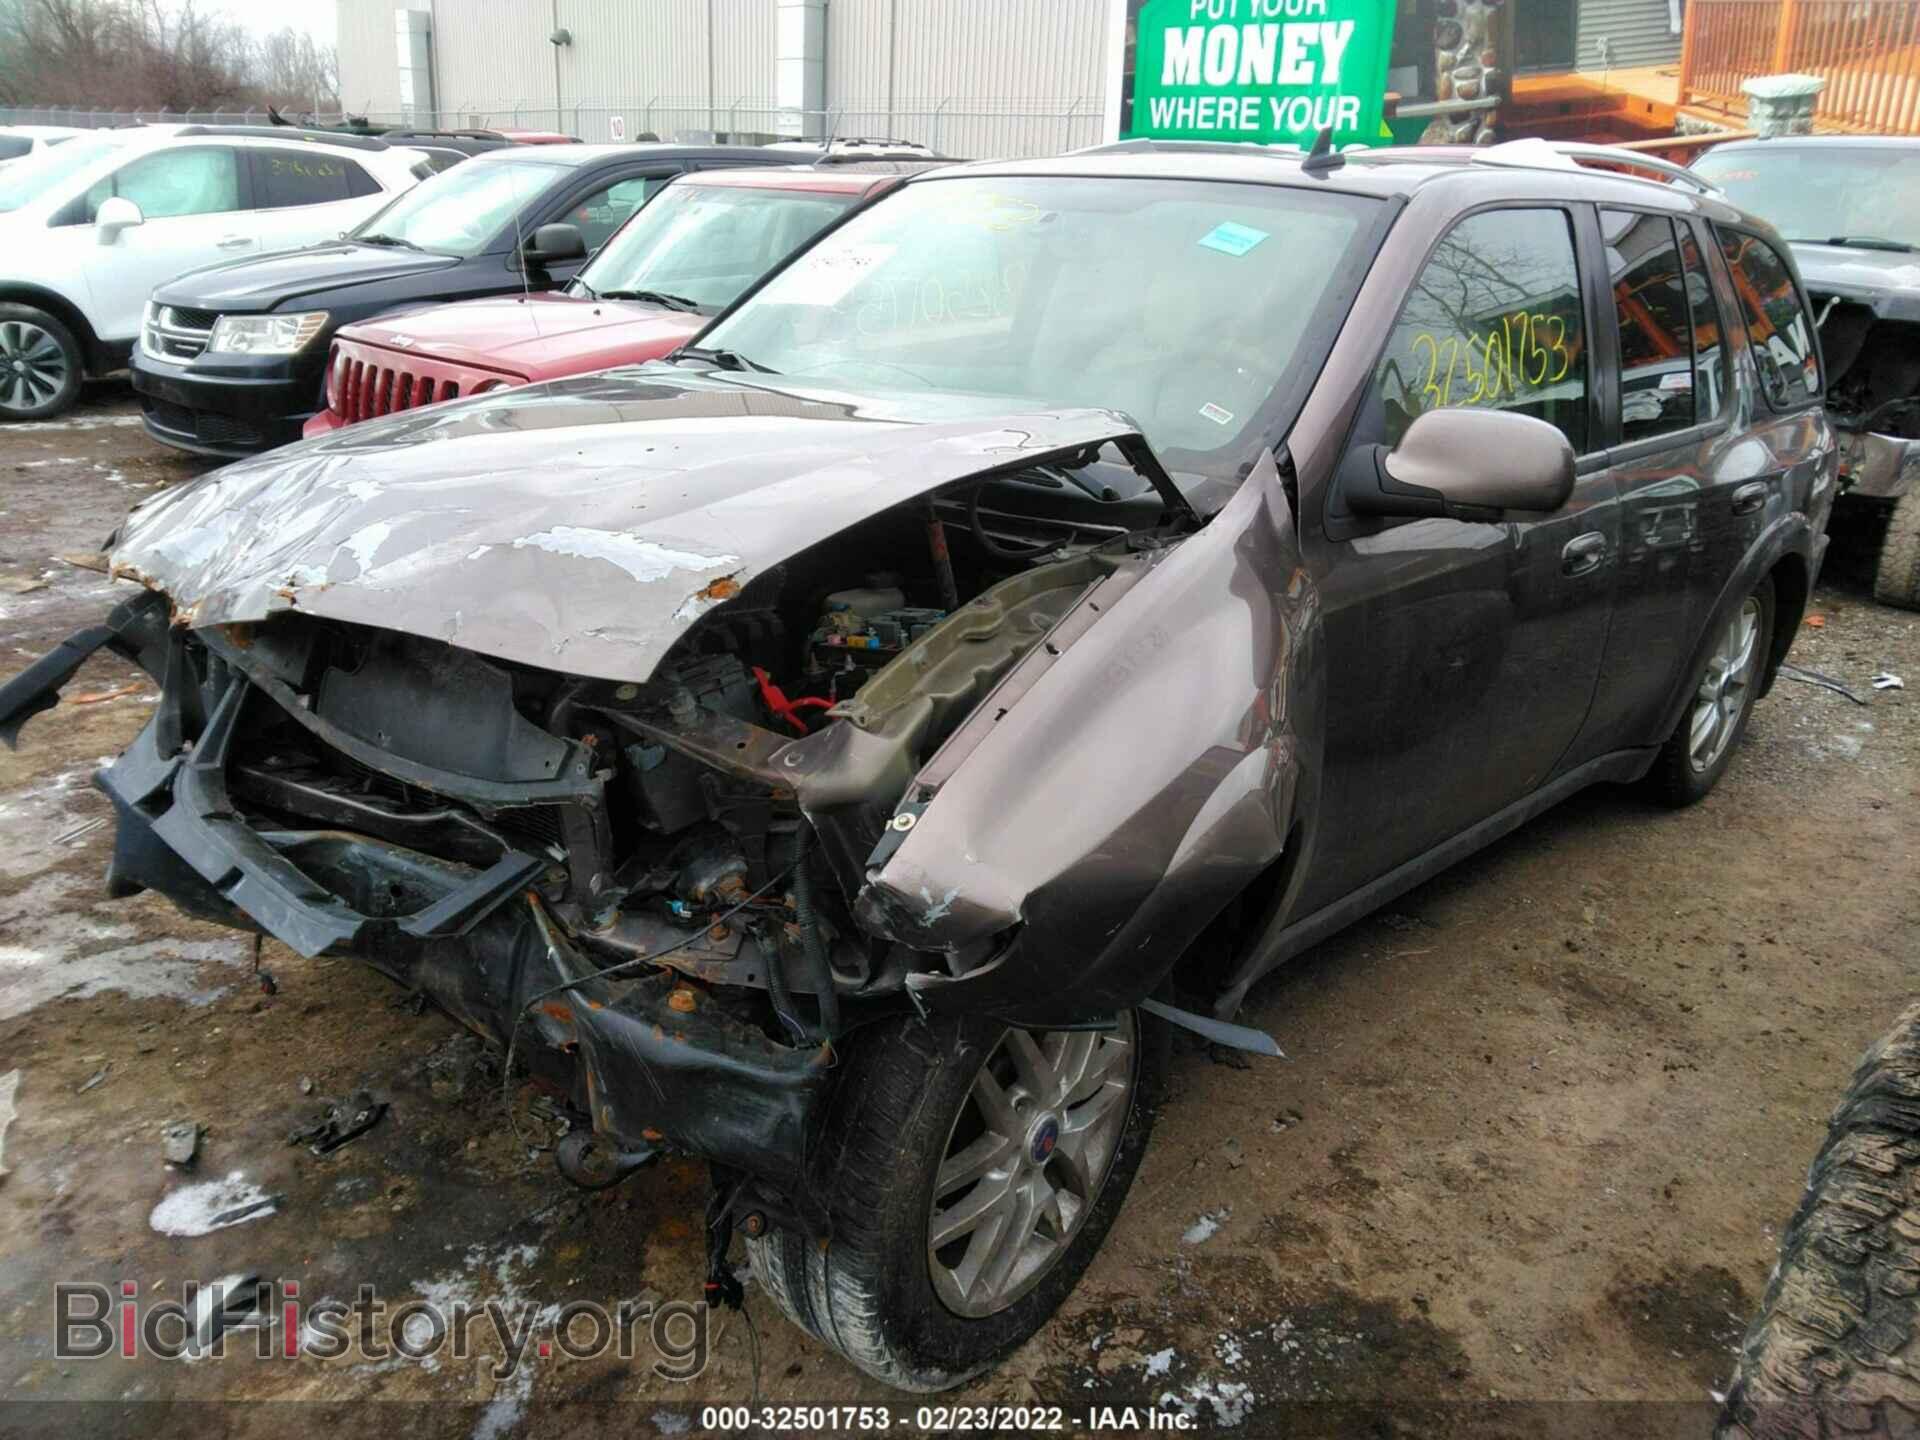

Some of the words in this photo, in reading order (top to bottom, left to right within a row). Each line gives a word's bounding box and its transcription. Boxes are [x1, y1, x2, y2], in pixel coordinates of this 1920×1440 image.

[1161, 20, 1355, 86] MONEY
[1150, 97, 1261, 129] WHERE
[1269, 95, 1361, 131] YOUR
